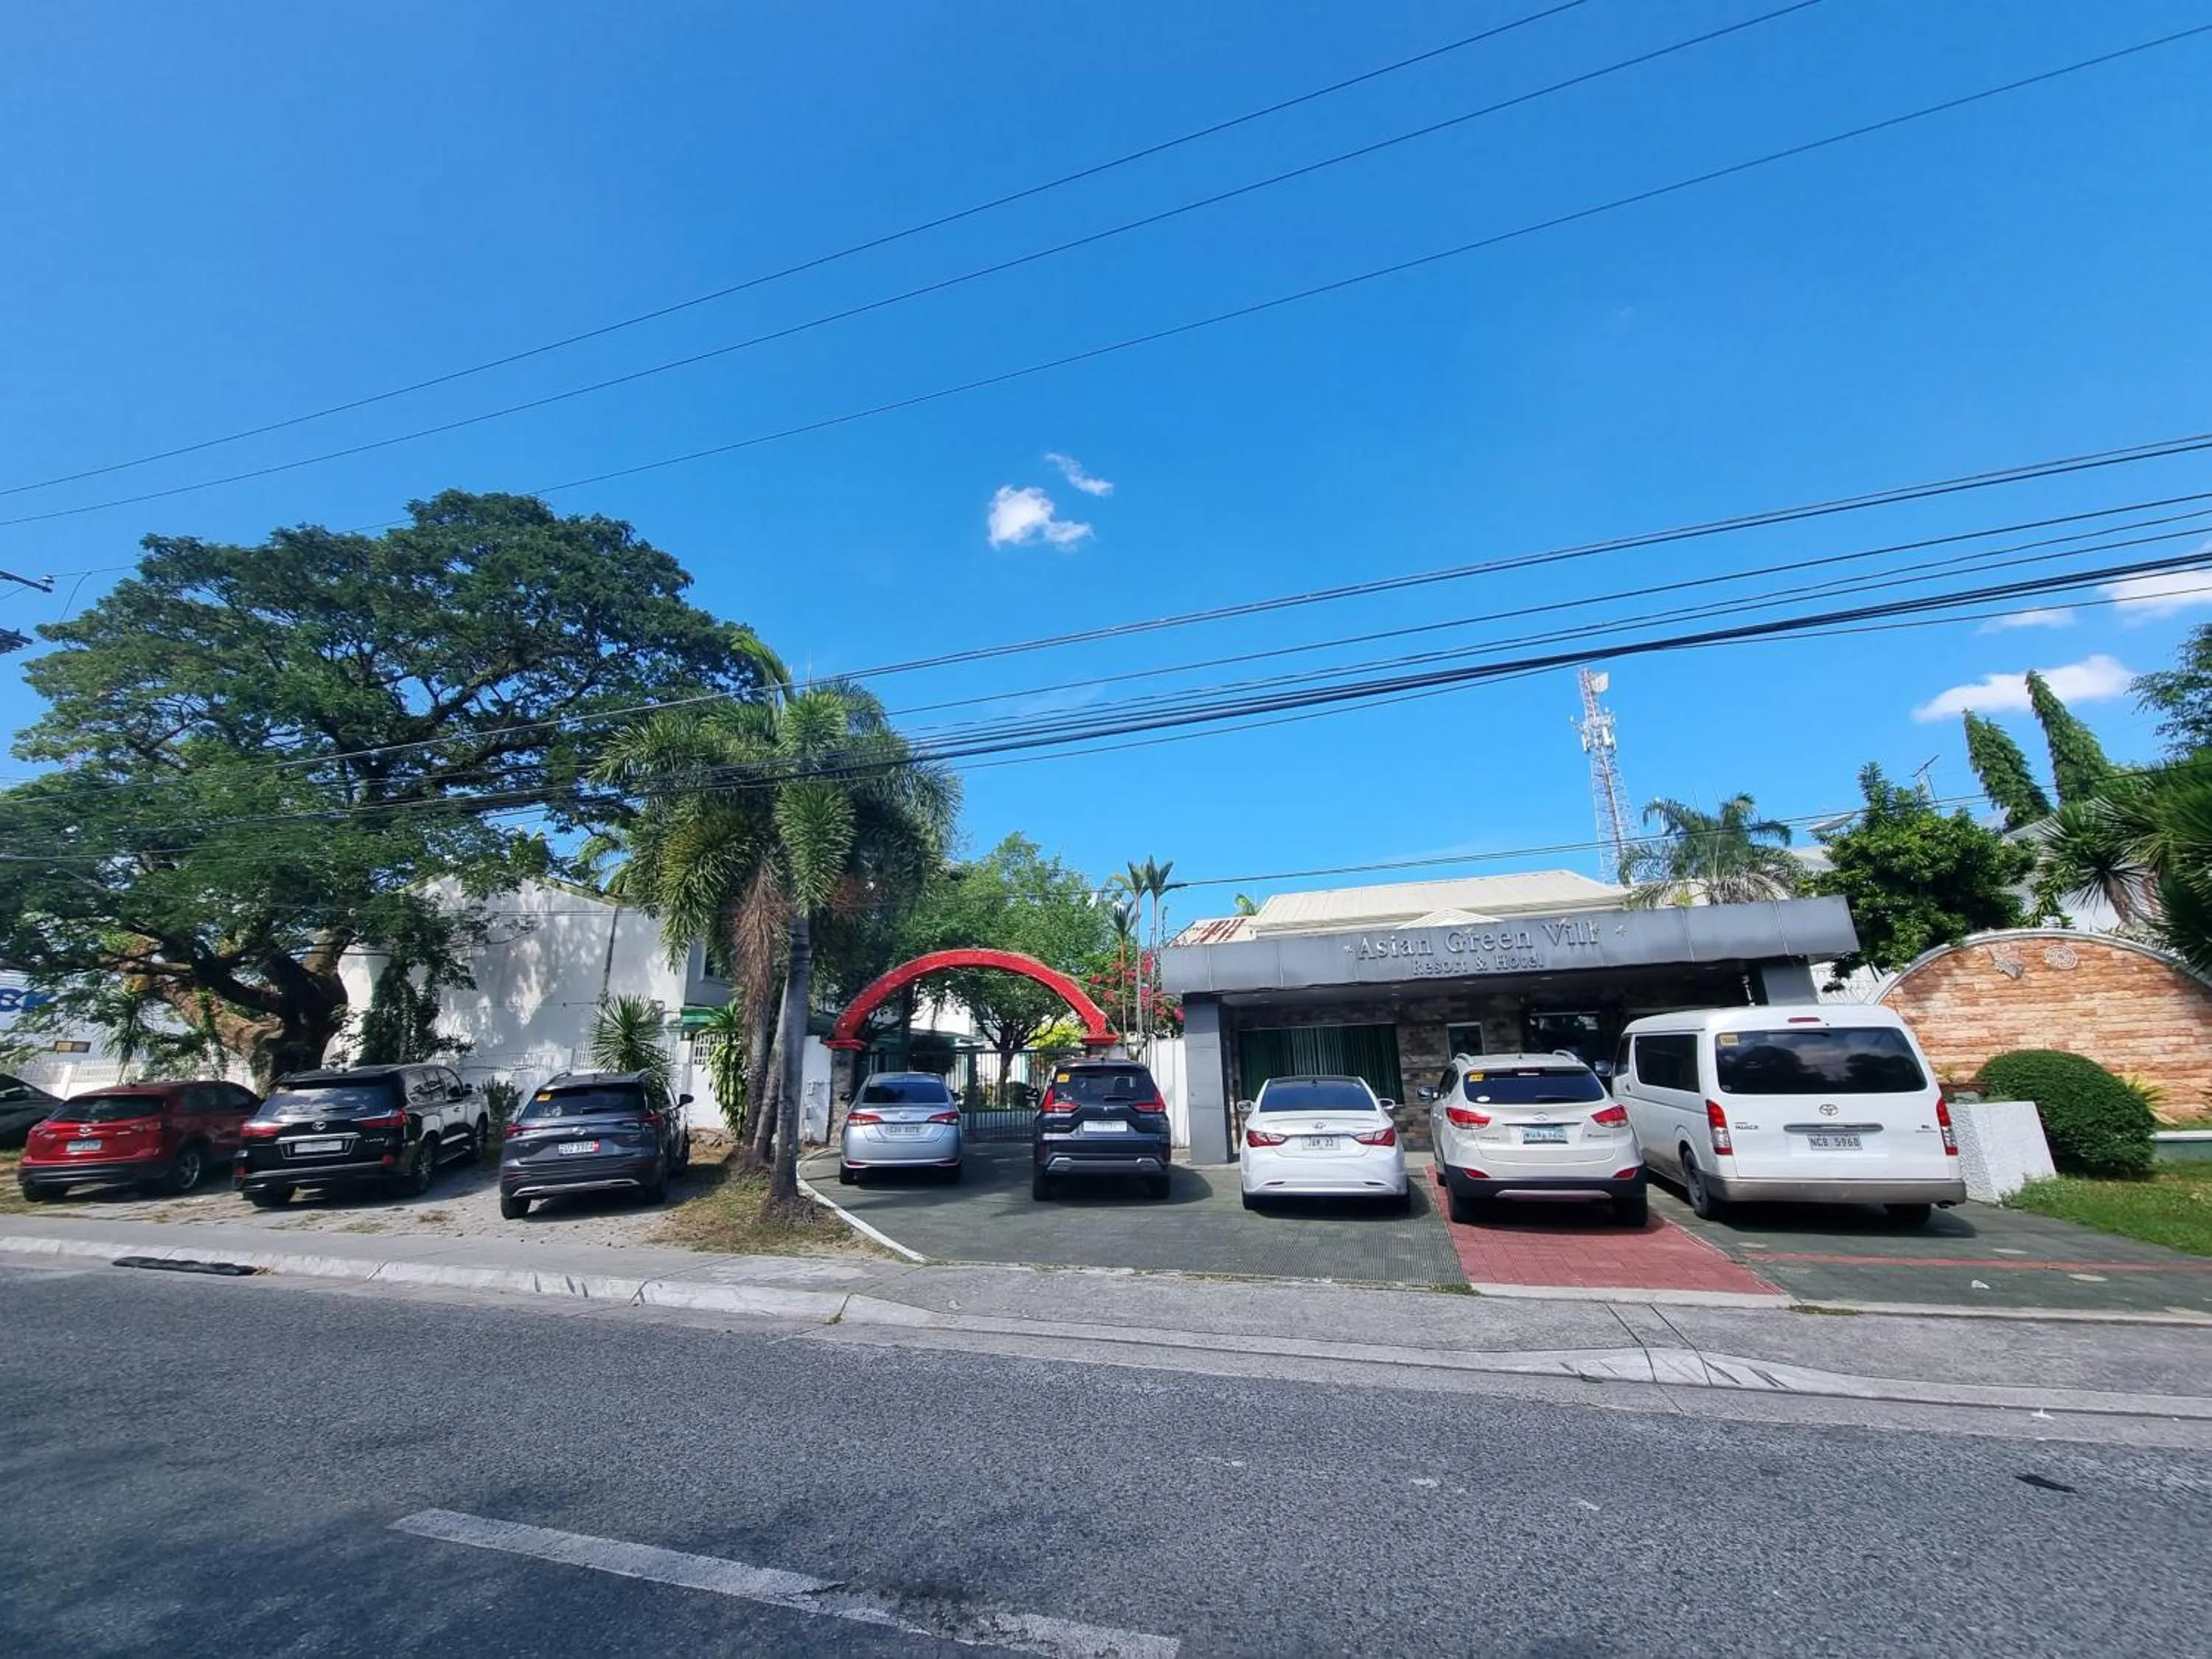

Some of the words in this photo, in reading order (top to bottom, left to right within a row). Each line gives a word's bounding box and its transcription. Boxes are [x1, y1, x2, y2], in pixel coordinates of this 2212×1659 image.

[1357, 935, 1434, 961] Asian
[1445, 931, 1534, 953] Green
[1412, 960, 1468, 975] Resort
[1475, 956, 1488, 971] &
[1494, 953, 1545, 971] Hotel
